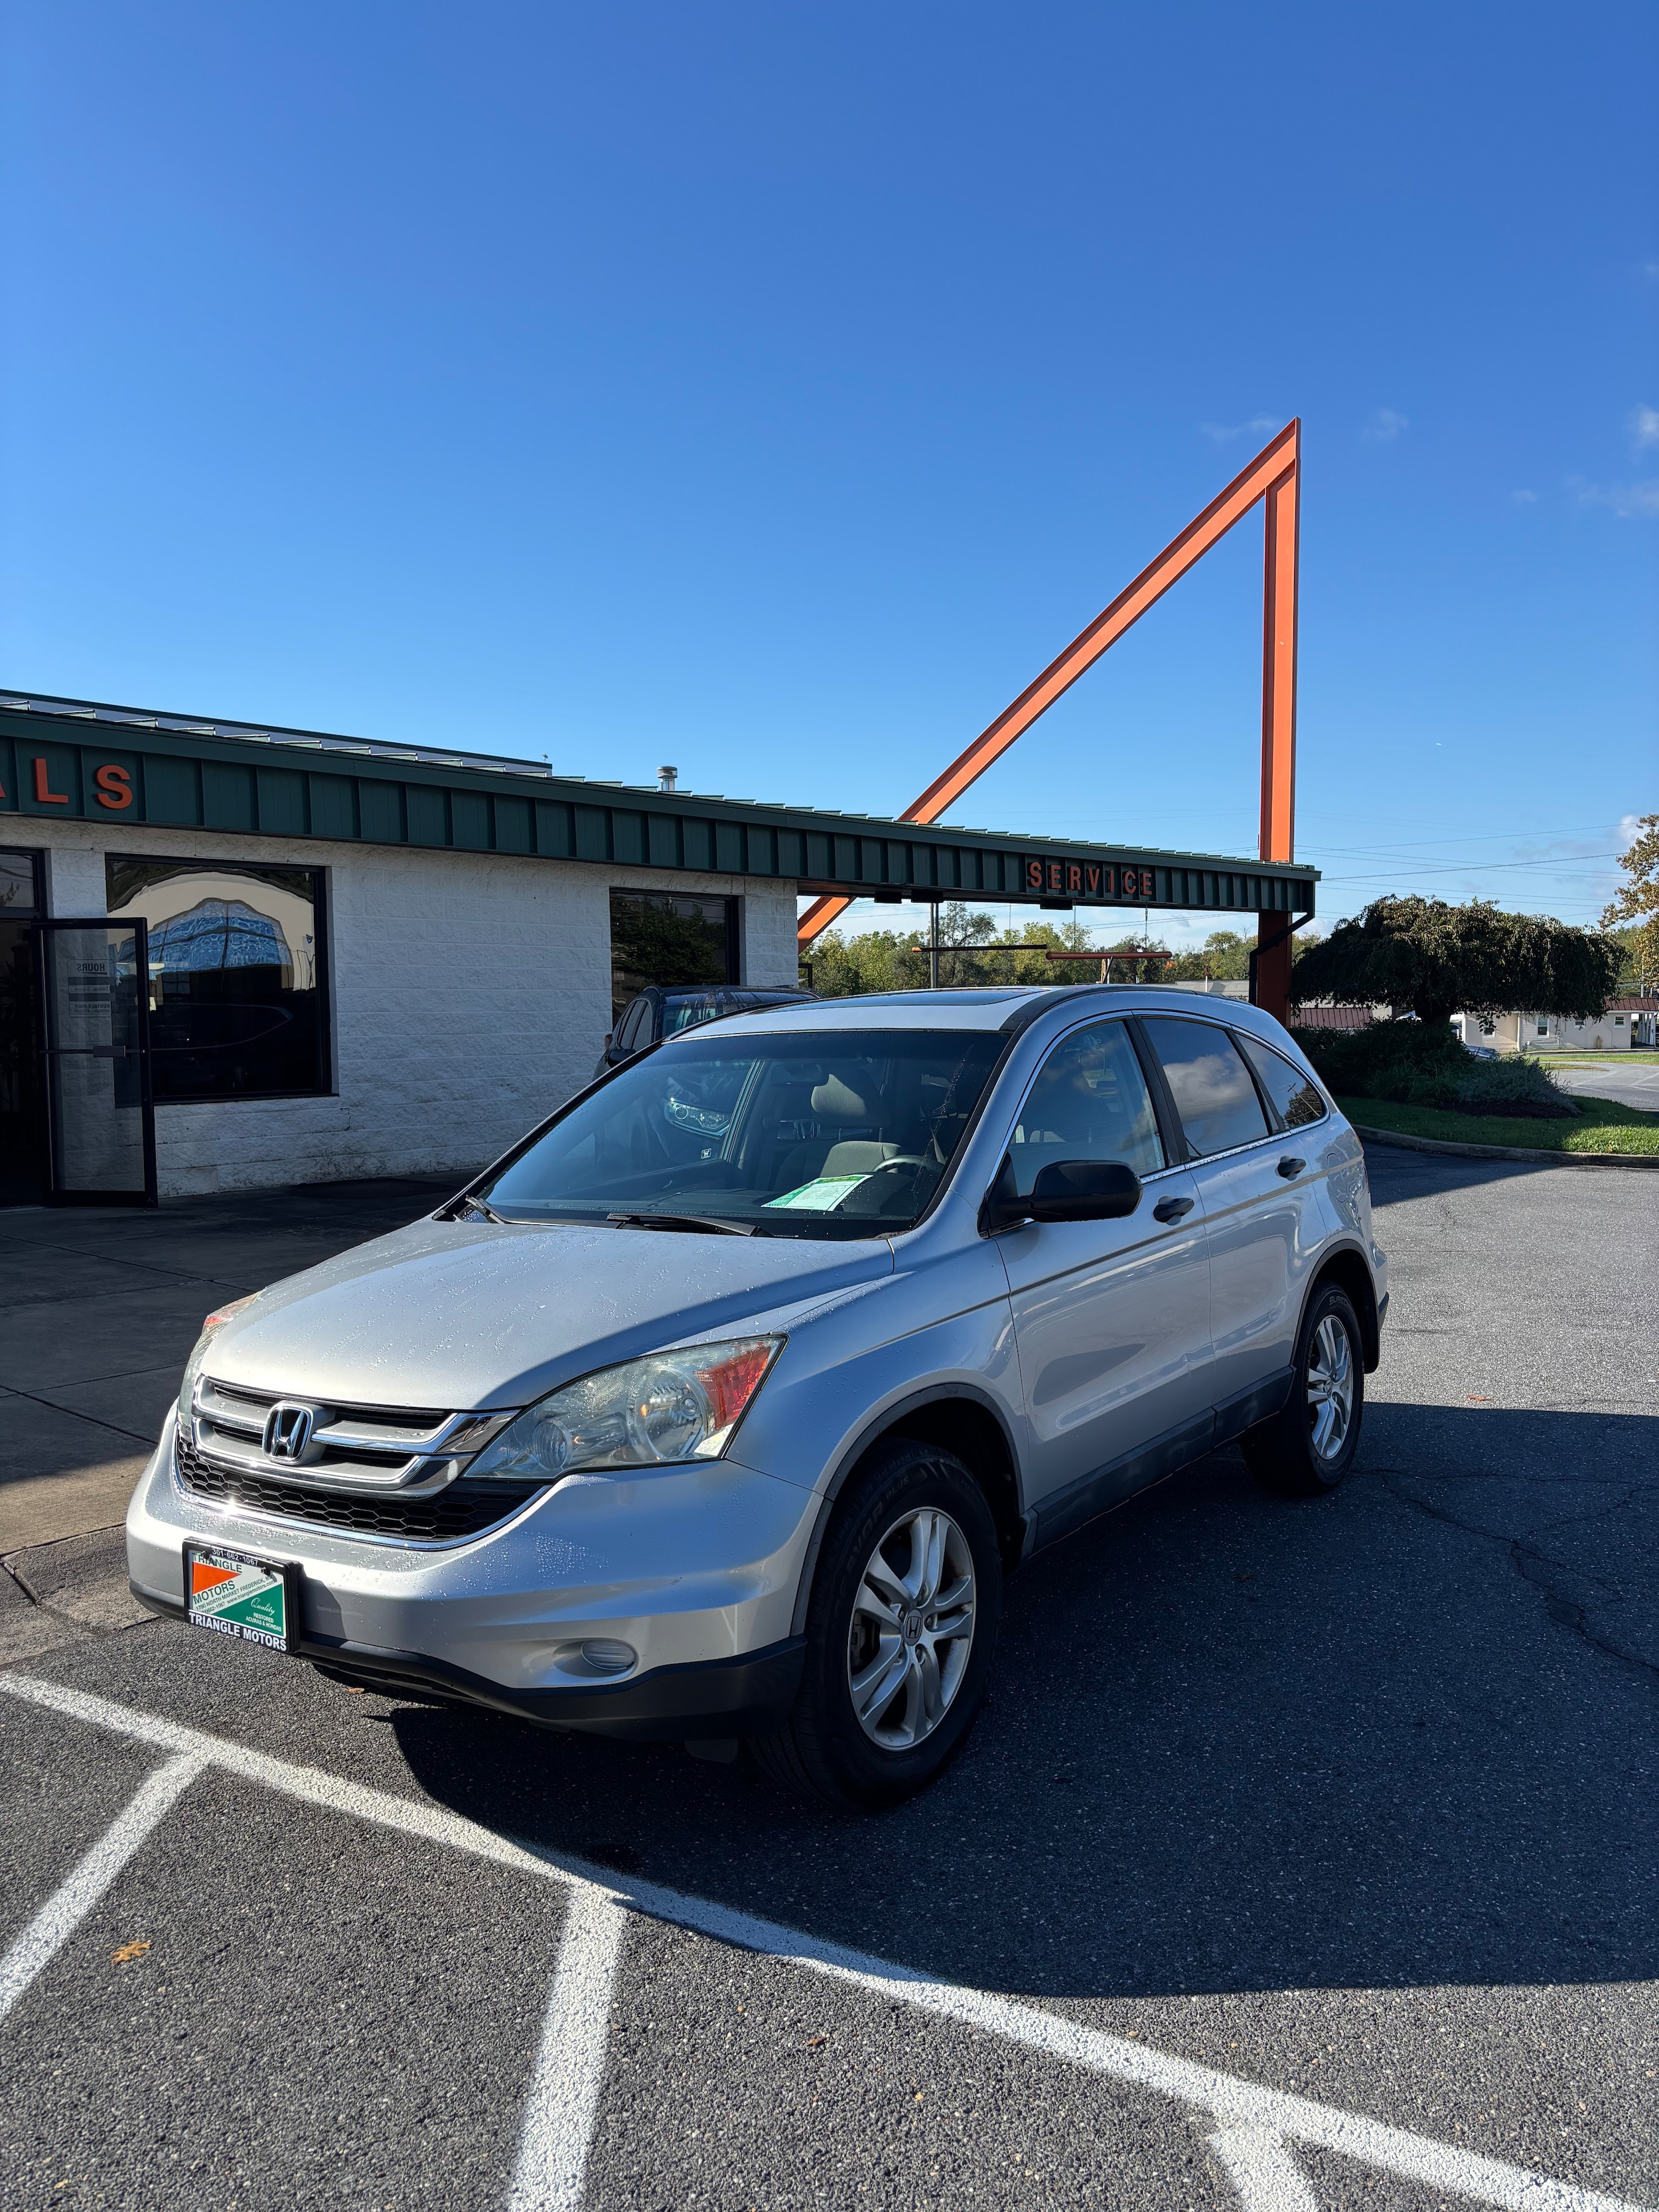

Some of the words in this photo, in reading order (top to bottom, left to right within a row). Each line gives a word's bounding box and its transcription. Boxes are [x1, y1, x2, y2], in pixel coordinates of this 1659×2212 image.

[0, 758, 133, 810] LS
[1029, 861, 1153, 895] SERVICE
[193, 1580, 236, 1605] MOTORS
[206, 1597, 222, 1607] NORTH
[222, 1588, 240, 1600] MARKET
[250, 1597, 275, 1616] Quality
[253, 1612, 274, 1623] RESTORED
[188, 1612, 241, 1637] TRIANGLE
[243, 1628, 287, 1651] MOTORS
[246, 1615, 262, 1625] ACURAS
[265, 1621, 282, 1632] HONDAS
